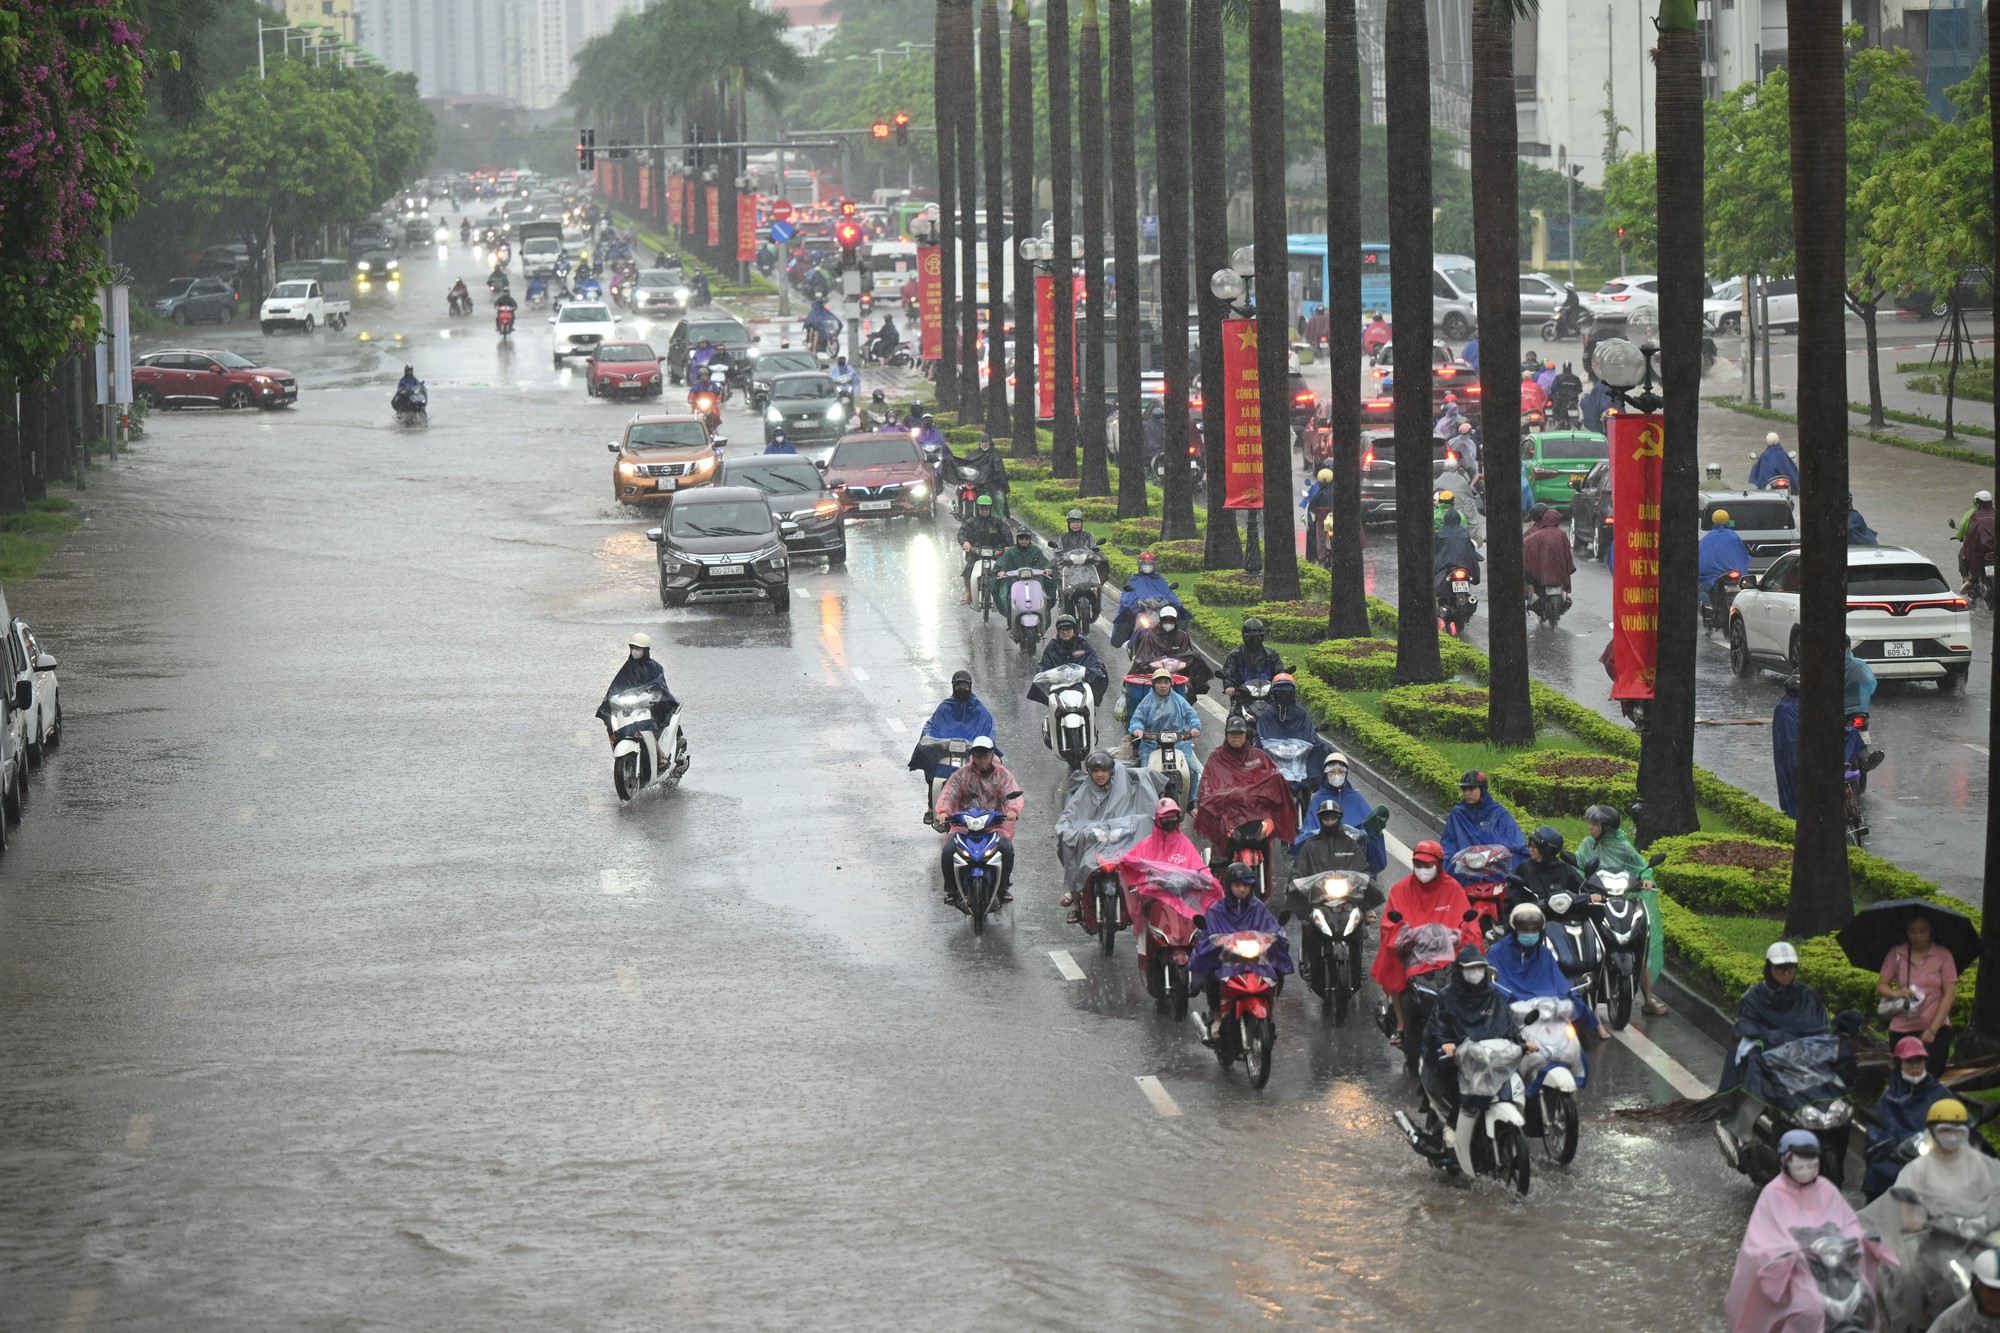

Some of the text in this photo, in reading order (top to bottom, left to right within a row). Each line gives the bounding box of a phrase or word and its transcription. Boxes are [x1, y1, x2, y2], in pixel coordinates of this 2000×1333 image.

[1236, 387, 1252, 401] CỘNG
[1237, 441, 1250, 458] VIỆT
[1628, 528, 1652, 551] CỘNG
[1630, 556, 1648, 579] VIỆT
[1623, 587, 1654, 604] QUANG
[1887, 649, 1911, 657] 609.47
[1892, 642, 1905, 650] 30K
